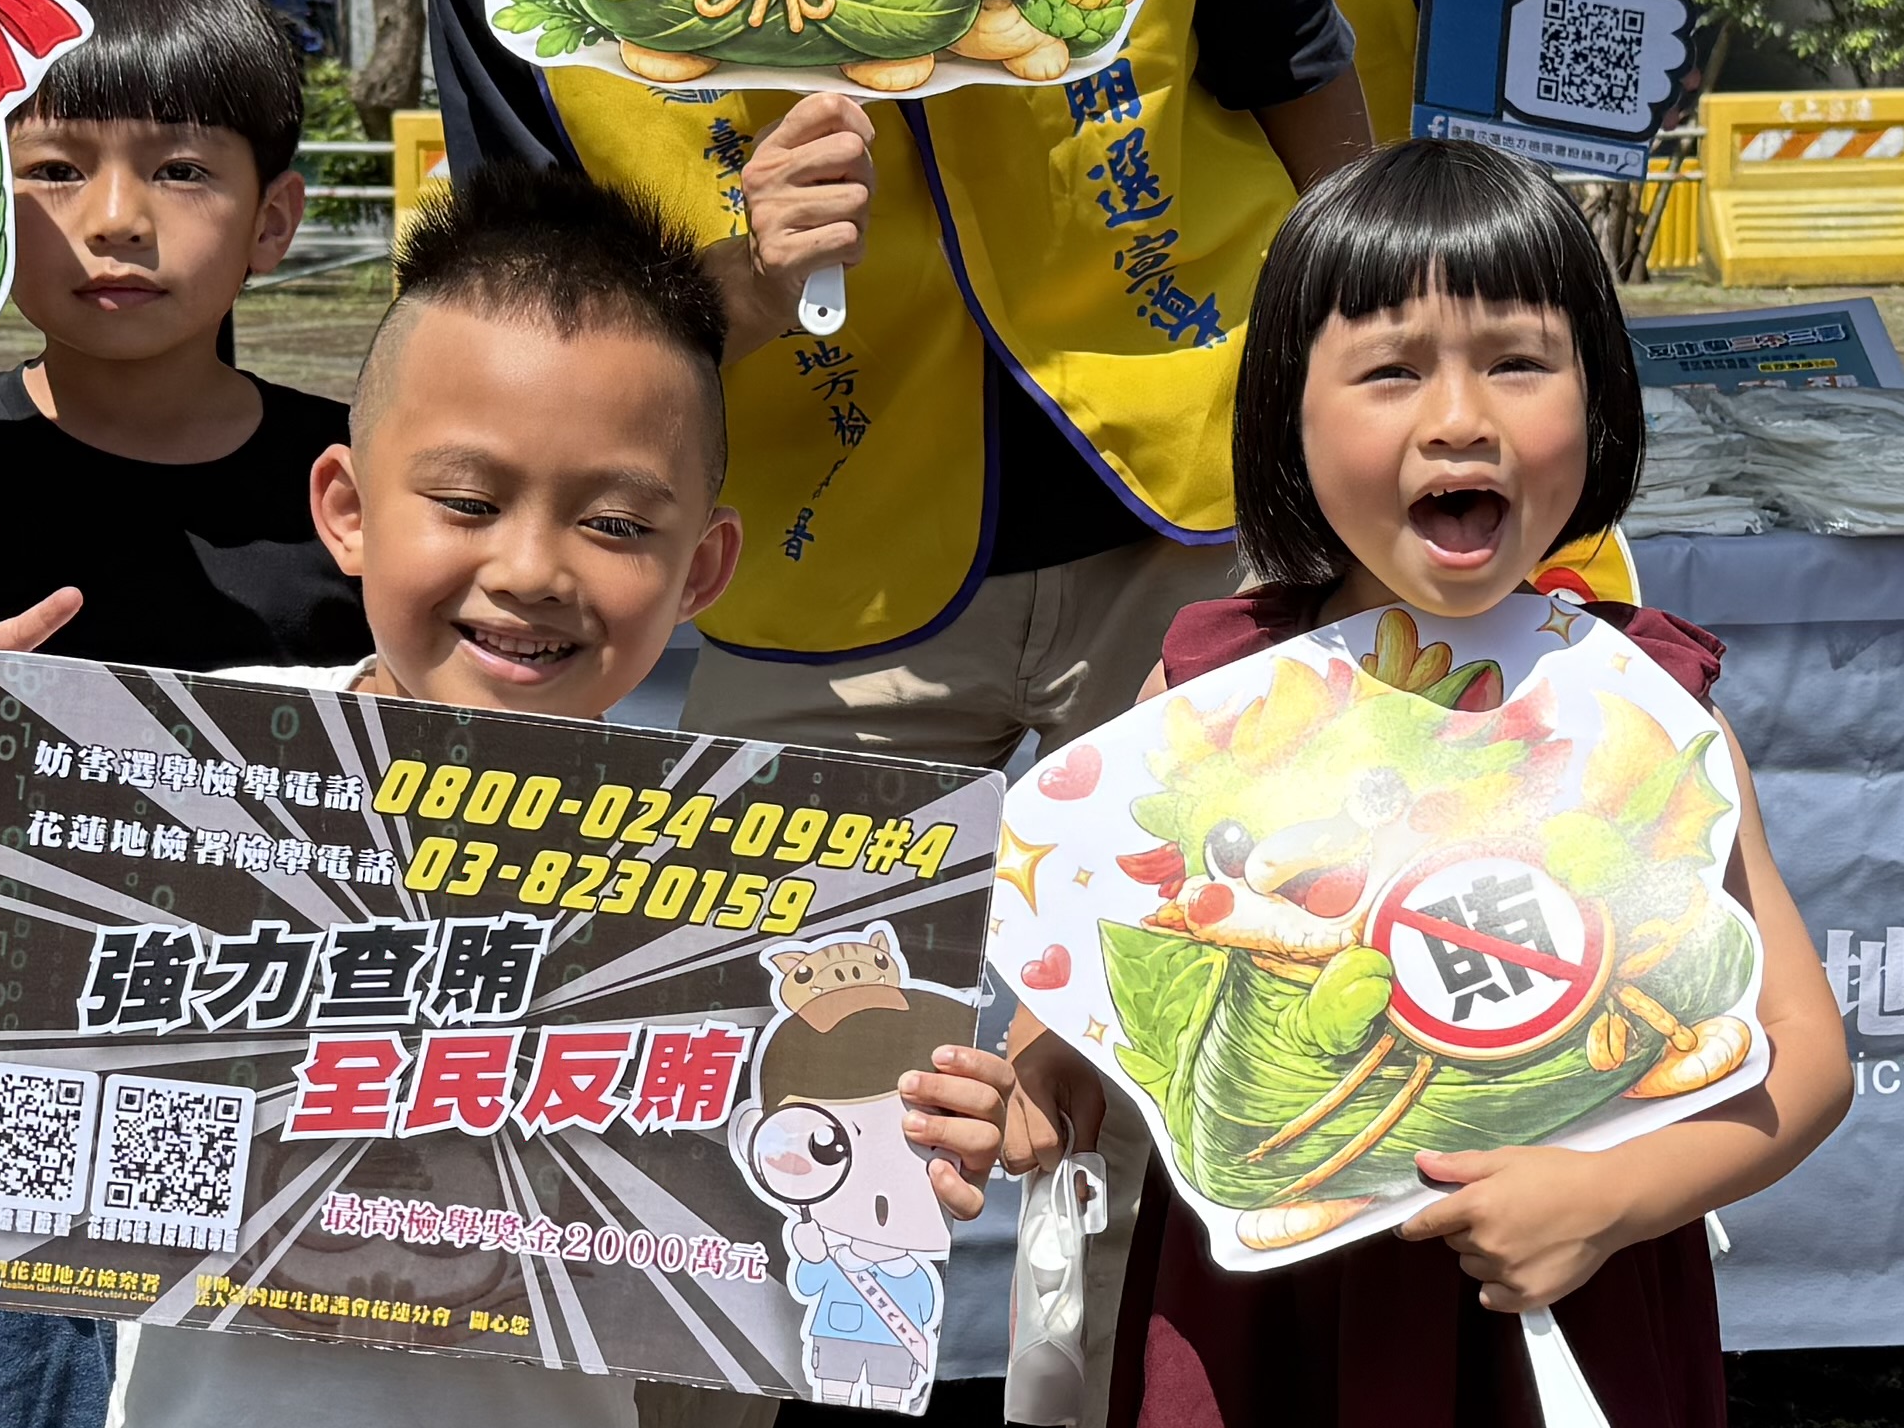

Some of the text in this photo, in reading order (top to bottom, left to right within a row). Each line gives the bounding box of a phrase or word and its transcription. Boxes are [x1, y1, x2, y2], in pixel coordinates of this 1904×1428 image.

[34, 740, 363, 813] 妨害選舉檢舉電話
[372, 758, 958, 879] 0800-024-099#4
[27, 810, 396, 887] 花蓮地檢署檢舉電話
[404, 836, 815, 935] 03-8230159
[77, 913, 553, 1034] 強力查賄
[282, 1021, 753, 1141] 全民反賄
[321, 1190, 769, 1283] 最高檢舉獎金2000萬元
[37, 1283, 70, 1295] District
[71, 1286, 128, 1301] Prosecutors
[129, 1291, 157, 1303] Office
